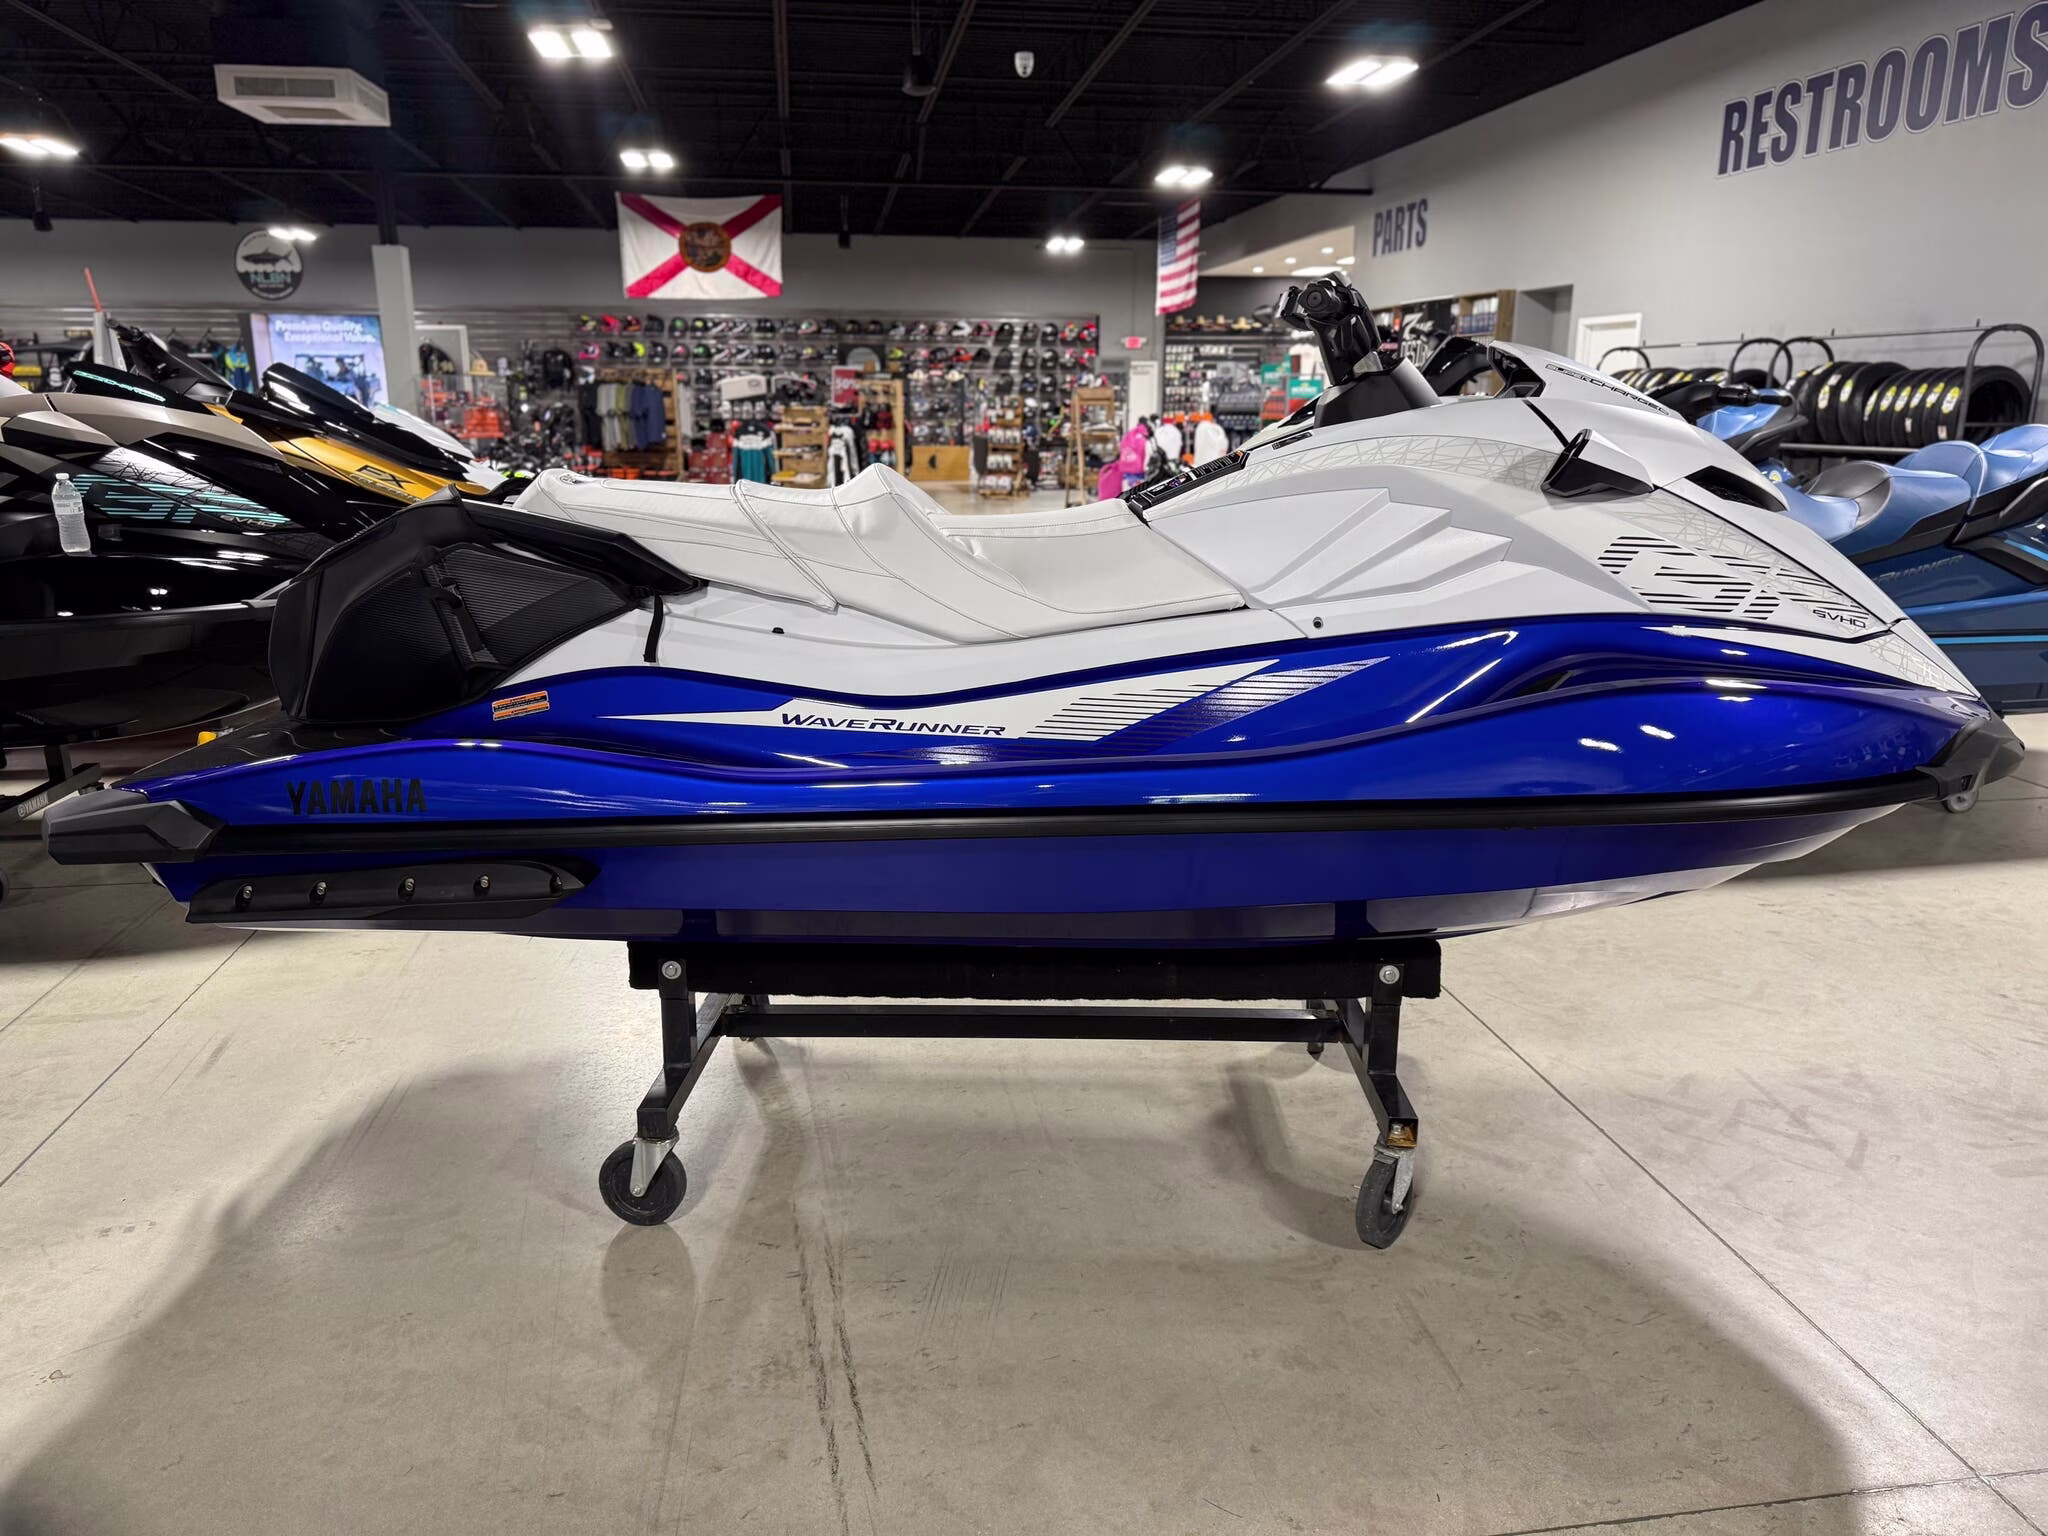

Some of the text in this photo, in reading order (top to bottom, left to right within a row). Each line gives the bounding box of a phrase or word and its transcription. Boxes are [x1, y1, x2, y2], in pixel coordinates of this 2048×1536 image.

[1717, 0, 2048, 178] RESTROOMS
[1372, 198, 1428, 257] PARTS
[275, 320, 321, 333] Premium
[1545, 364, 1669, 416] SUPERCHARGED
[1812, 608, 1866, 629] SVHO
[287, 777, 428, 816] YAMAHA
